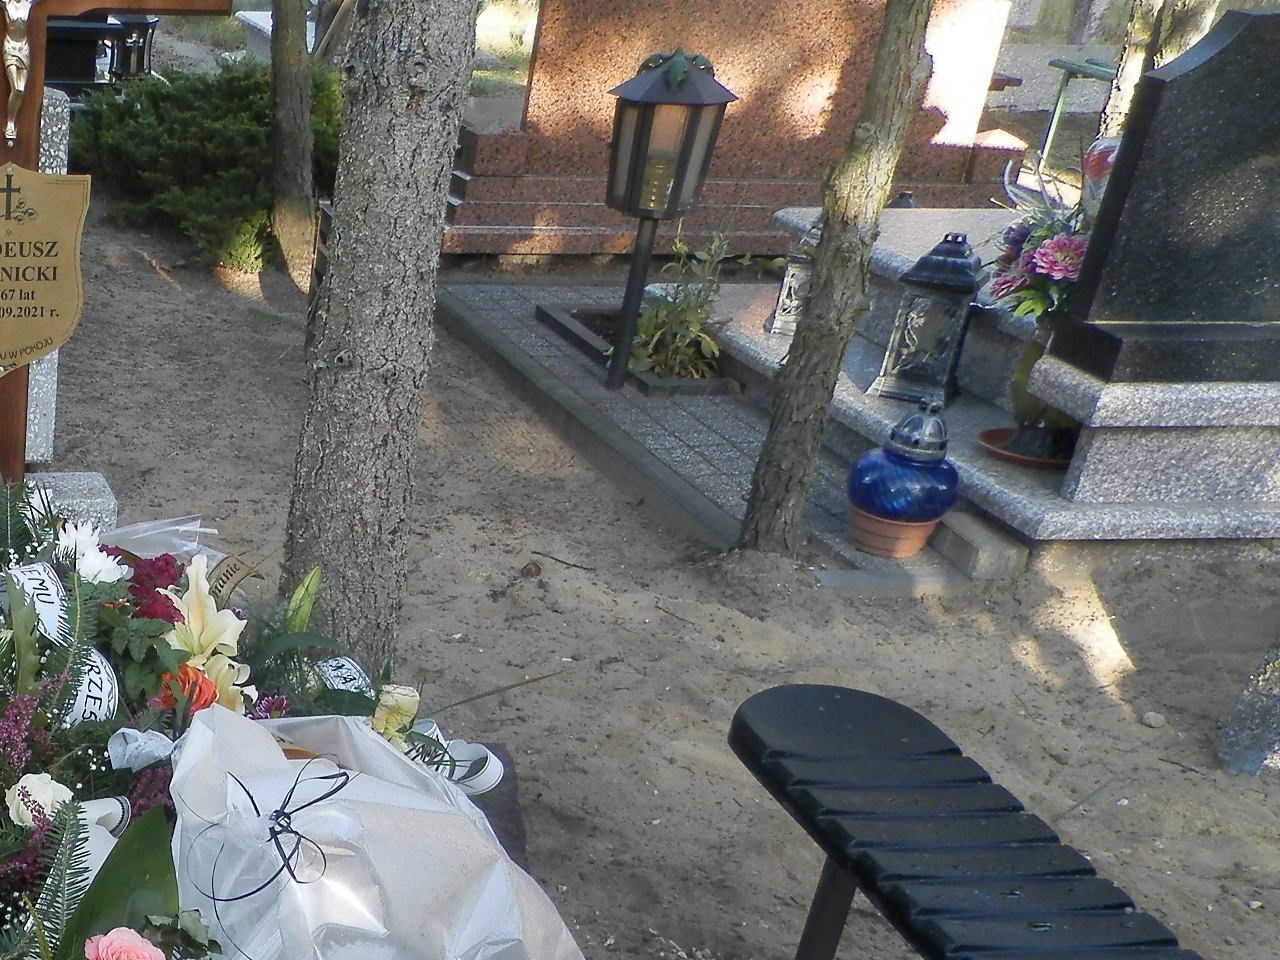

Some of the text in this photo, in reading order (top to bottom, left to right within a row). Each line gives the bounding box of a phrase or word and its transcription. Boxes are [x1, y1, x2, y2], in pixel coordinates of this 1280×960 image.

[0, 288, 16, 301] 67
[19, 288, 36, 301] lat
[49, 308, 60, 318] r.
[8, 350, 19, 360] W
[19, 336, 55, 357] POKOJU
